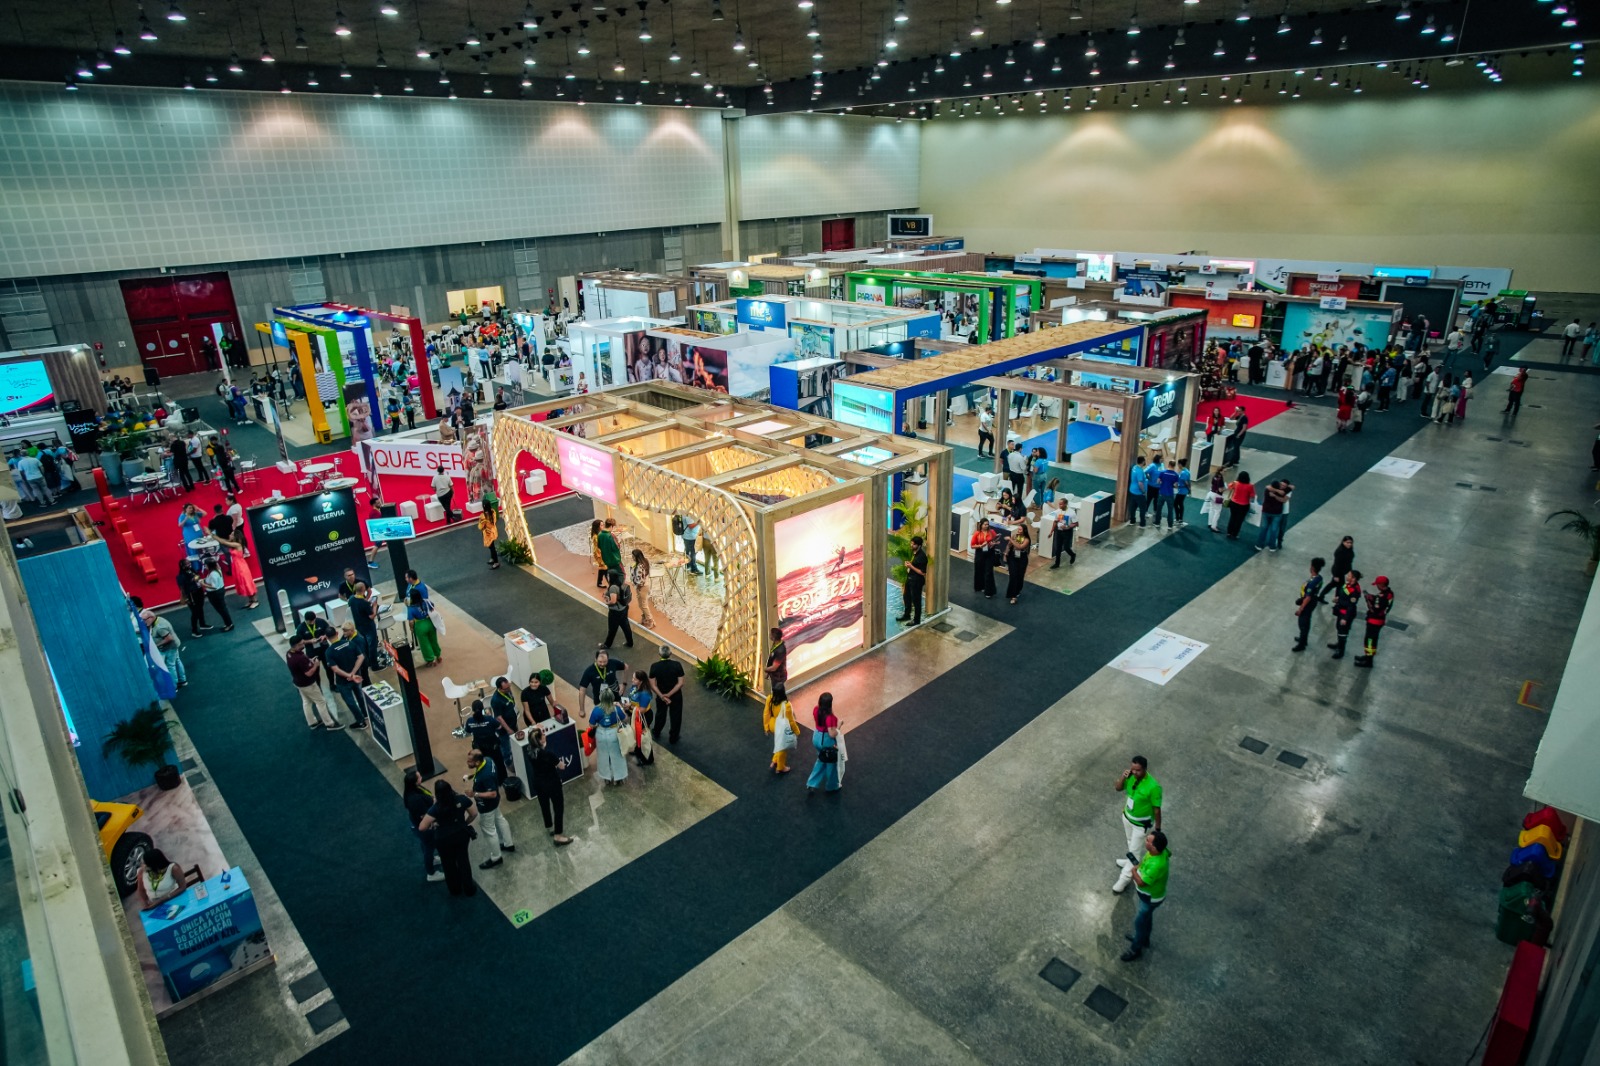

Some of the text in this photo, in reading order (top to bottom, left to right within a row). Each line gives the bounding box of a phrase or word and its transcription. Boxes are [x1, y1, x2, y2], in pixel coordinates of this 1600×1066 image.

[906, 221, 916, 229] VB
[261, 516, 298, 531] FLYTOUR
[312, 509, 345, 522] RESERVIA
[314, 536, 356, 552] QUEENSBERRY
[268, 549, 307, 565] QUALITOURS
[307, 580, 331, 593] BeFly
[173, 902, 229, 937] A ÚNICA PRAIA
[175, 909, 232, 944] DO CEARÁ COM
[178, 918, 233, 951] CERTIFICAÇÃO
